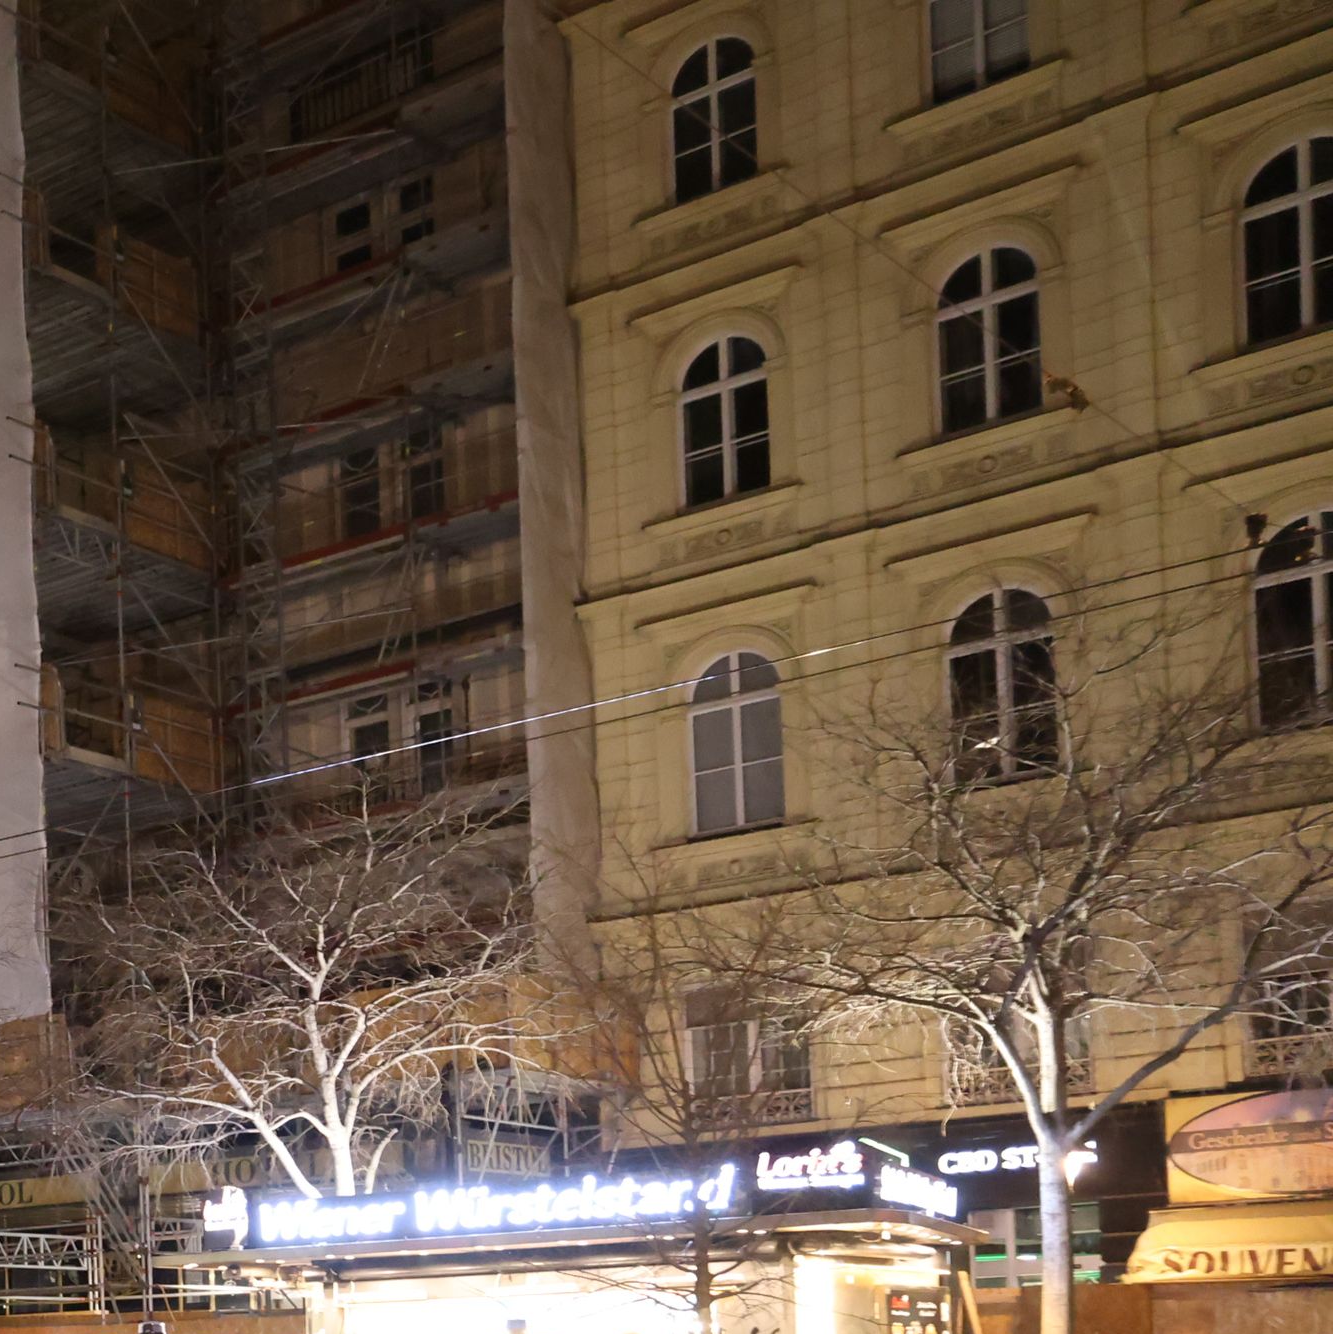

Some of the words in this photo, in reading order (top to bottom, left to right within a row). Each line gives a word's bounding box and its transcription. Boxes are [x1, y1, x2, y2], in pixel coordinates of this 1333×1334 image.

[938, 1149, 998, 1175] CBD
[258, 1197, 406, 1242] Wiener
[1164, 1247, 1333, 1275] SOUVEN
